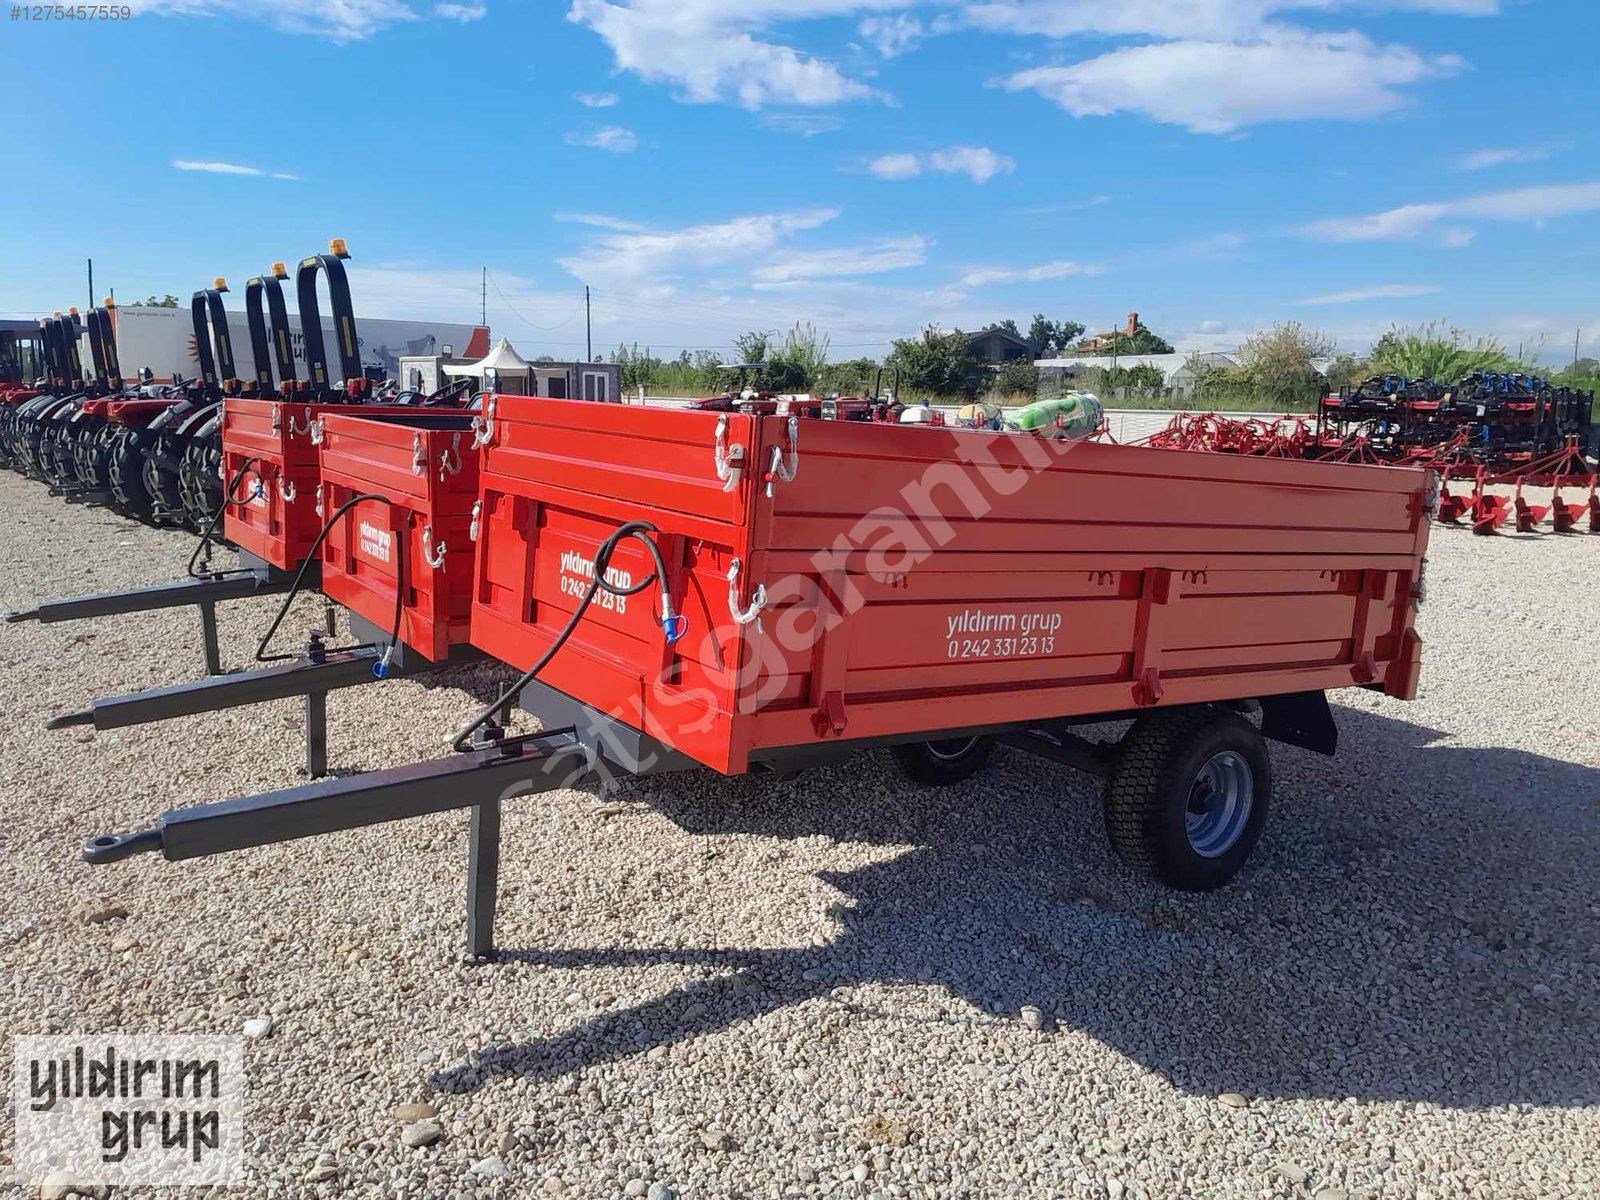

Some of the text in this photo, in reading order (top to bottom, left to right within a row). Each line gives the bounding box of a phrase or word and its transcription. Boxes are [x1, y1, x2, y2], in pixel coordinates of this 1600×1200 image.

[560, 575, 568, 593] 0
[568, 577, 586, 600] 242
[602, 589, 614, 610] 23
[616, 594, 626, 615] 13
[946, 609, 1062, 639] yıldırım grup
[947, 636, 1055, 659] 0 242 331 23 13
